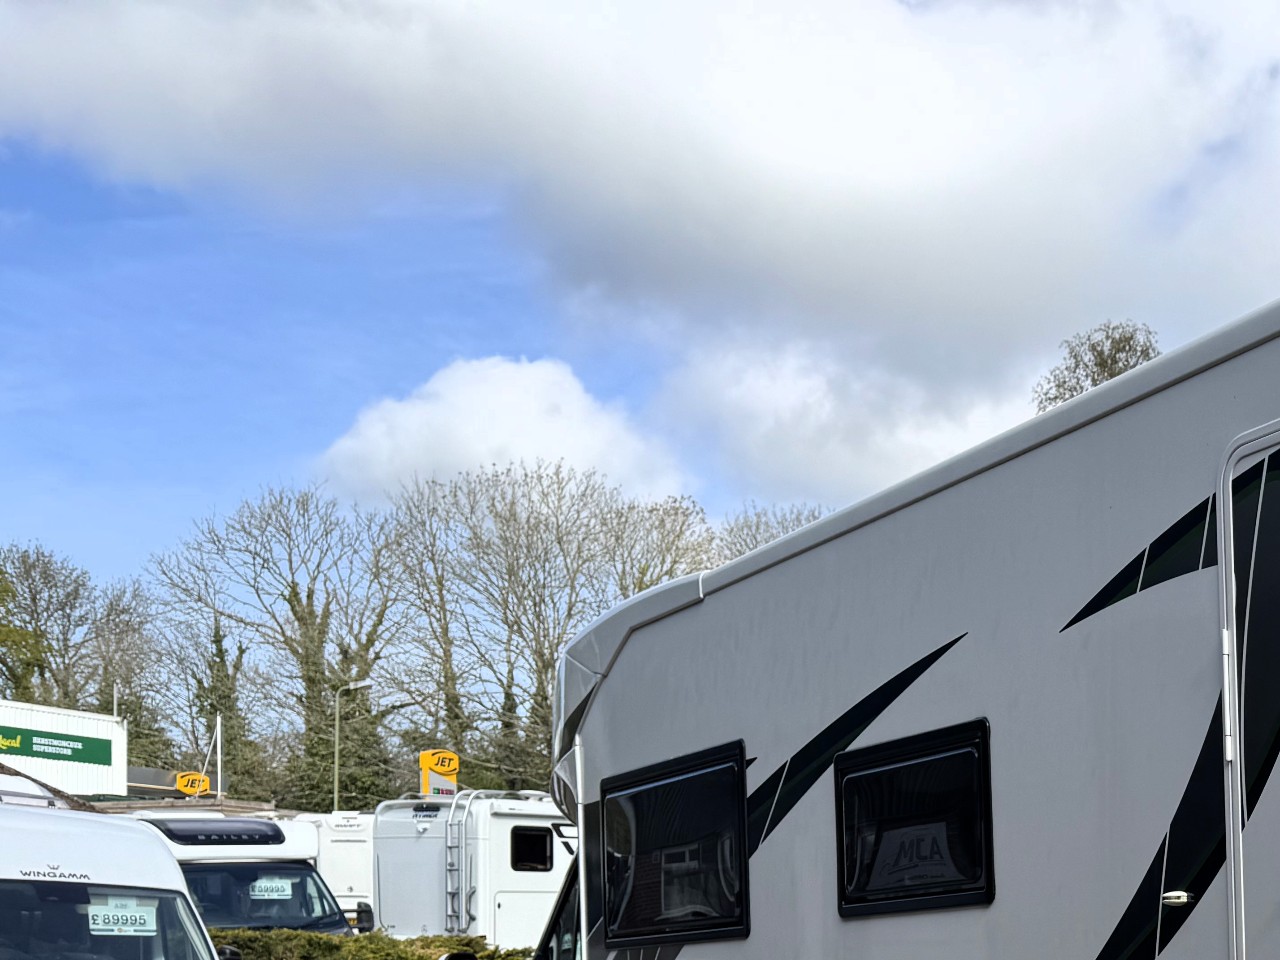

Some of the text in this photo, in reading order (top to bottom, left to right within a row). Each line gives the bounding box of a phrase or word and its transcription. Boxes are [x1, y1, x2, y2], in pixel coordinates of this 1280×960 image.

[435, 756, 454, 768] JET
[184, 778, 205, 789] JET
[20, 870, 91, 880] WINGAMM
